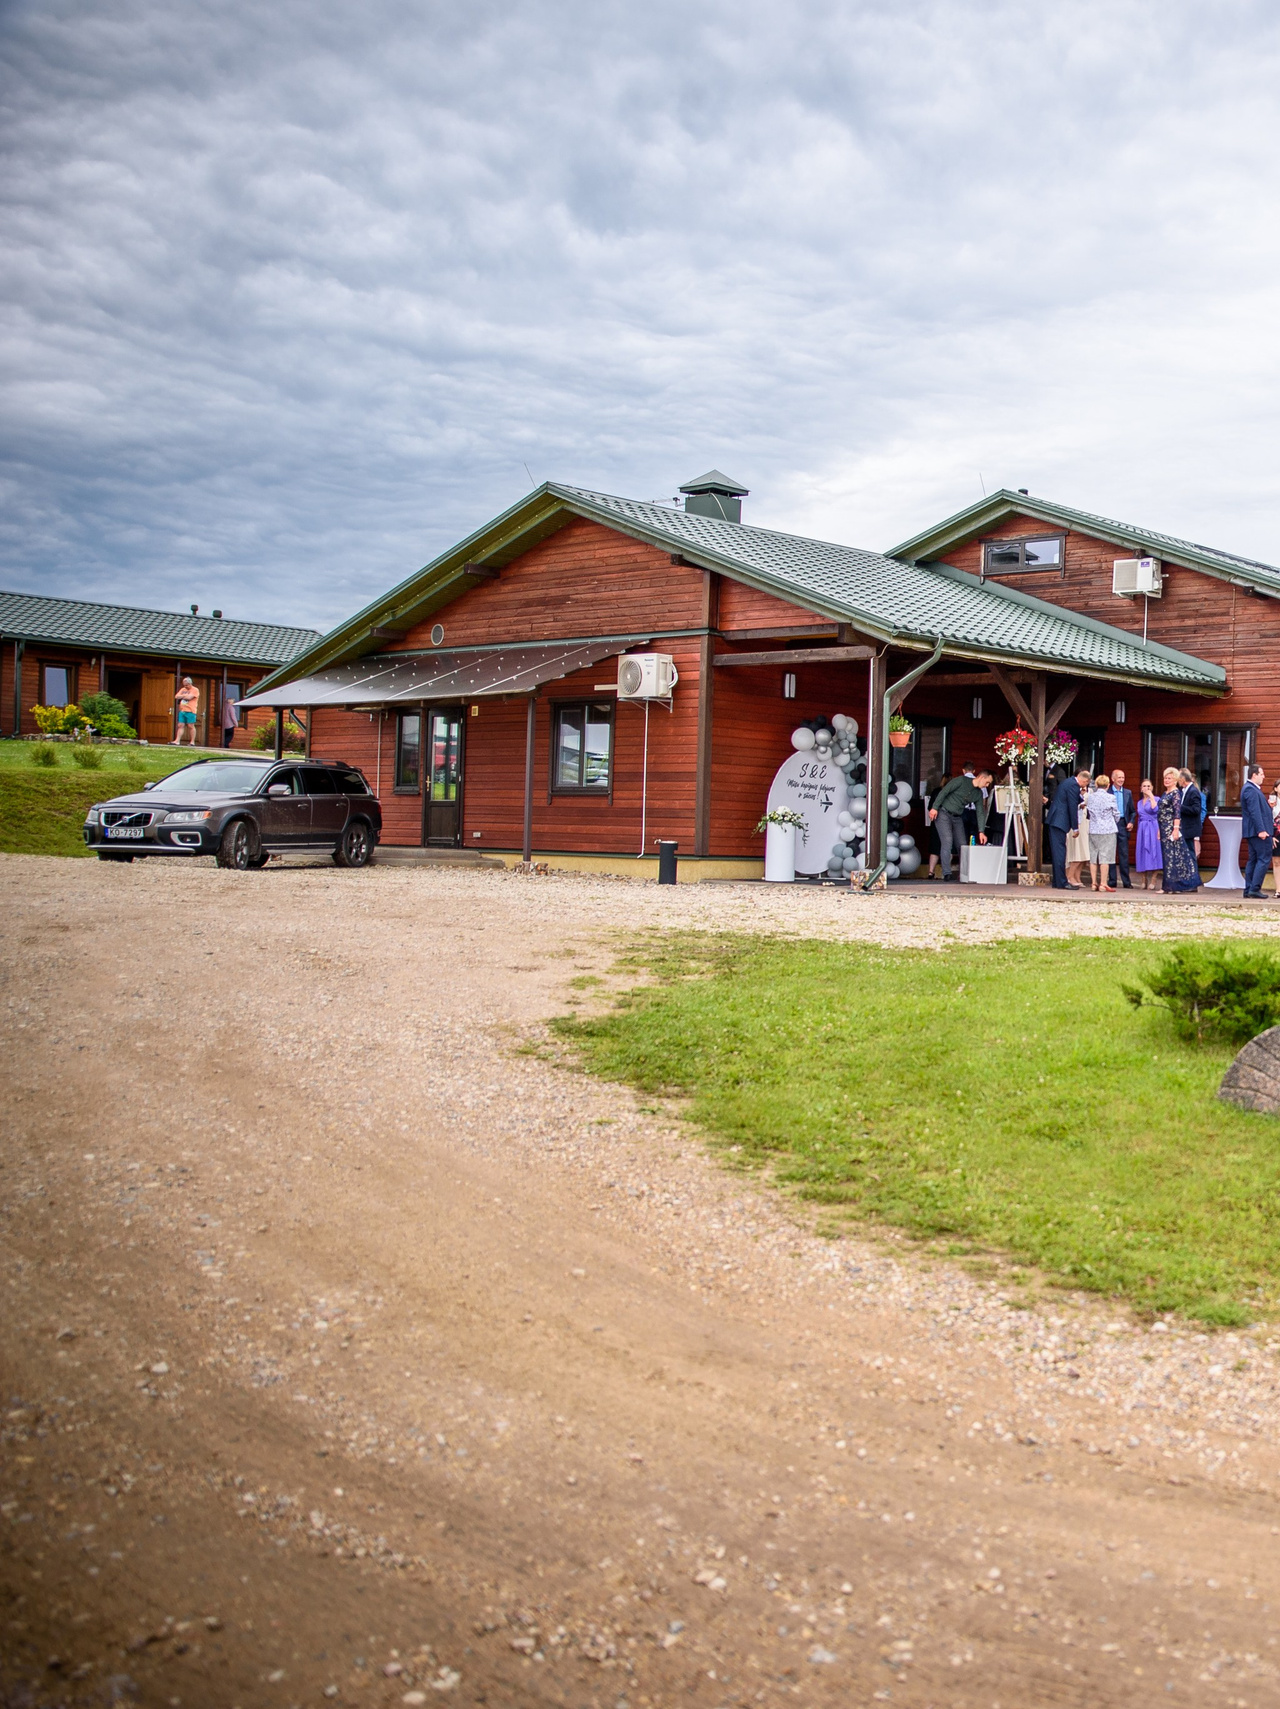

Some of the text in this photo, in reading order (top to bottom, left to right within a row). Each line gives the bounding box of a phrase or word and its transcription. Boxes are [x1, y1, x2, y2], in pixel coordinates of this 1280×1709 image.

[799, 763, 827, 779] S & E
